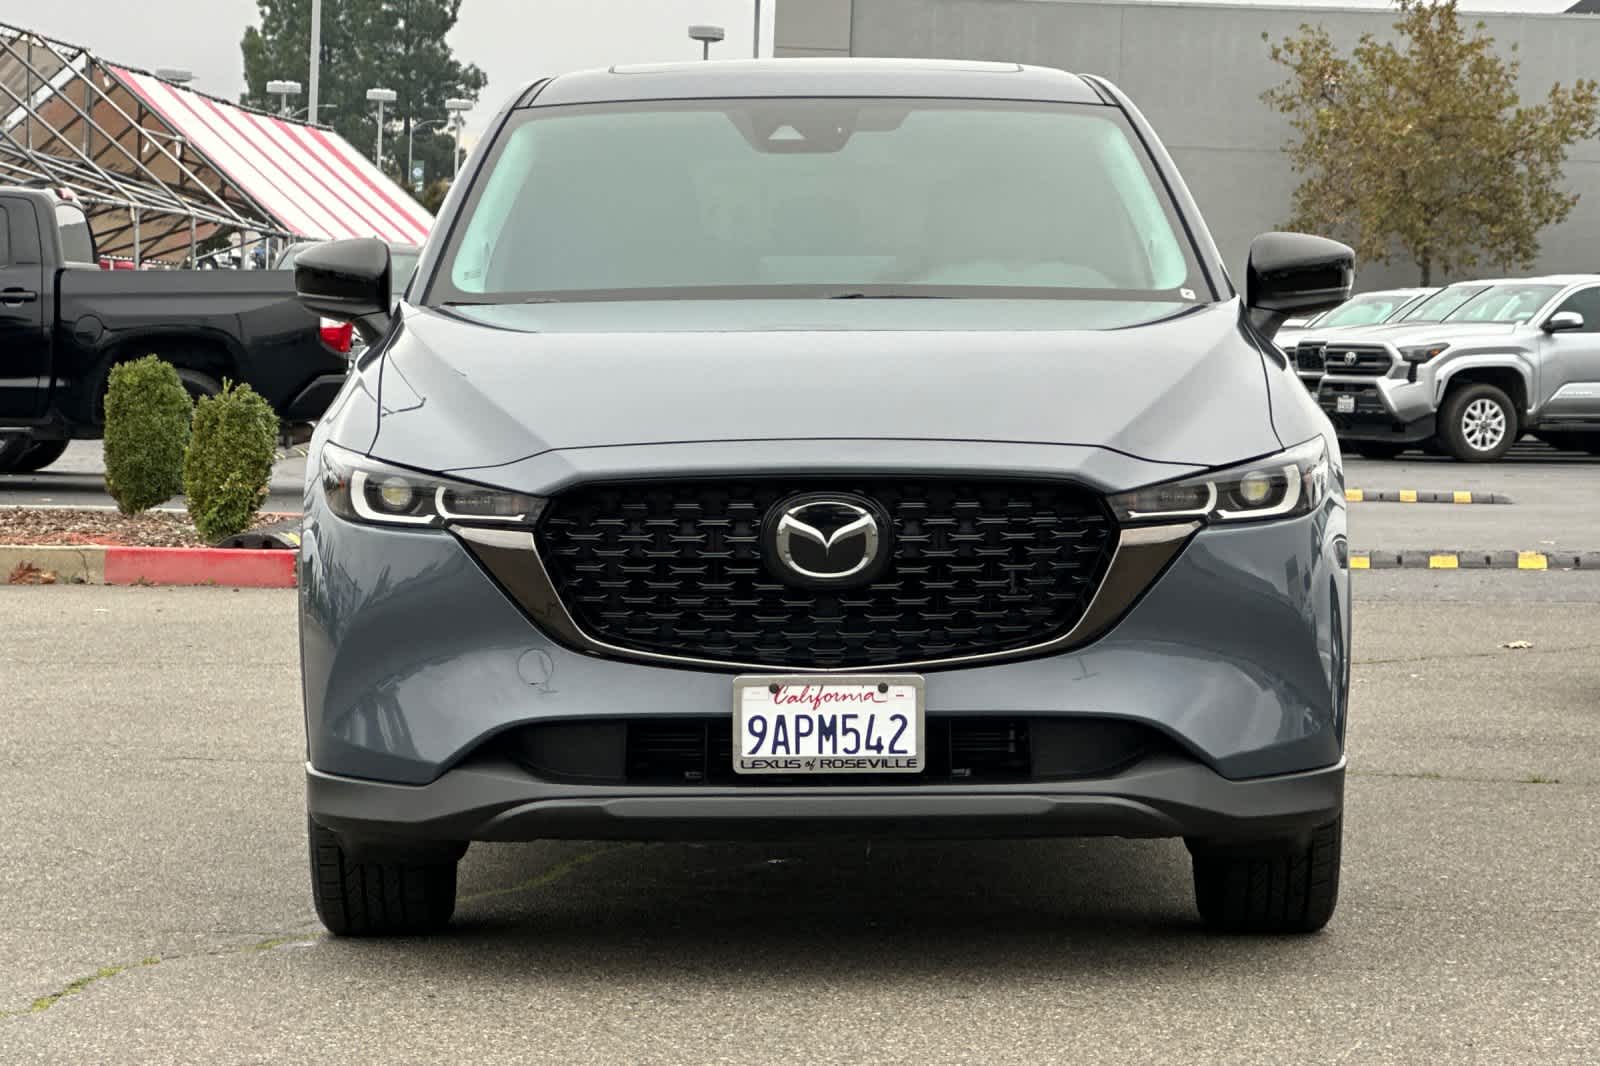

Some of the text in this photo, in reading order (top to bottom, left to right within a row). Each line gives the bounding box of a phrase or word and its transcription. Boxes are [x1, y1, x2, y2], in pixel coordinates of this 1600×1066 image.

[773, 685, 888, 711] California
[747, 714, 909, 755] 9APM542
[740, 758, 918, 771] LEXUS of ROSEVILLE
